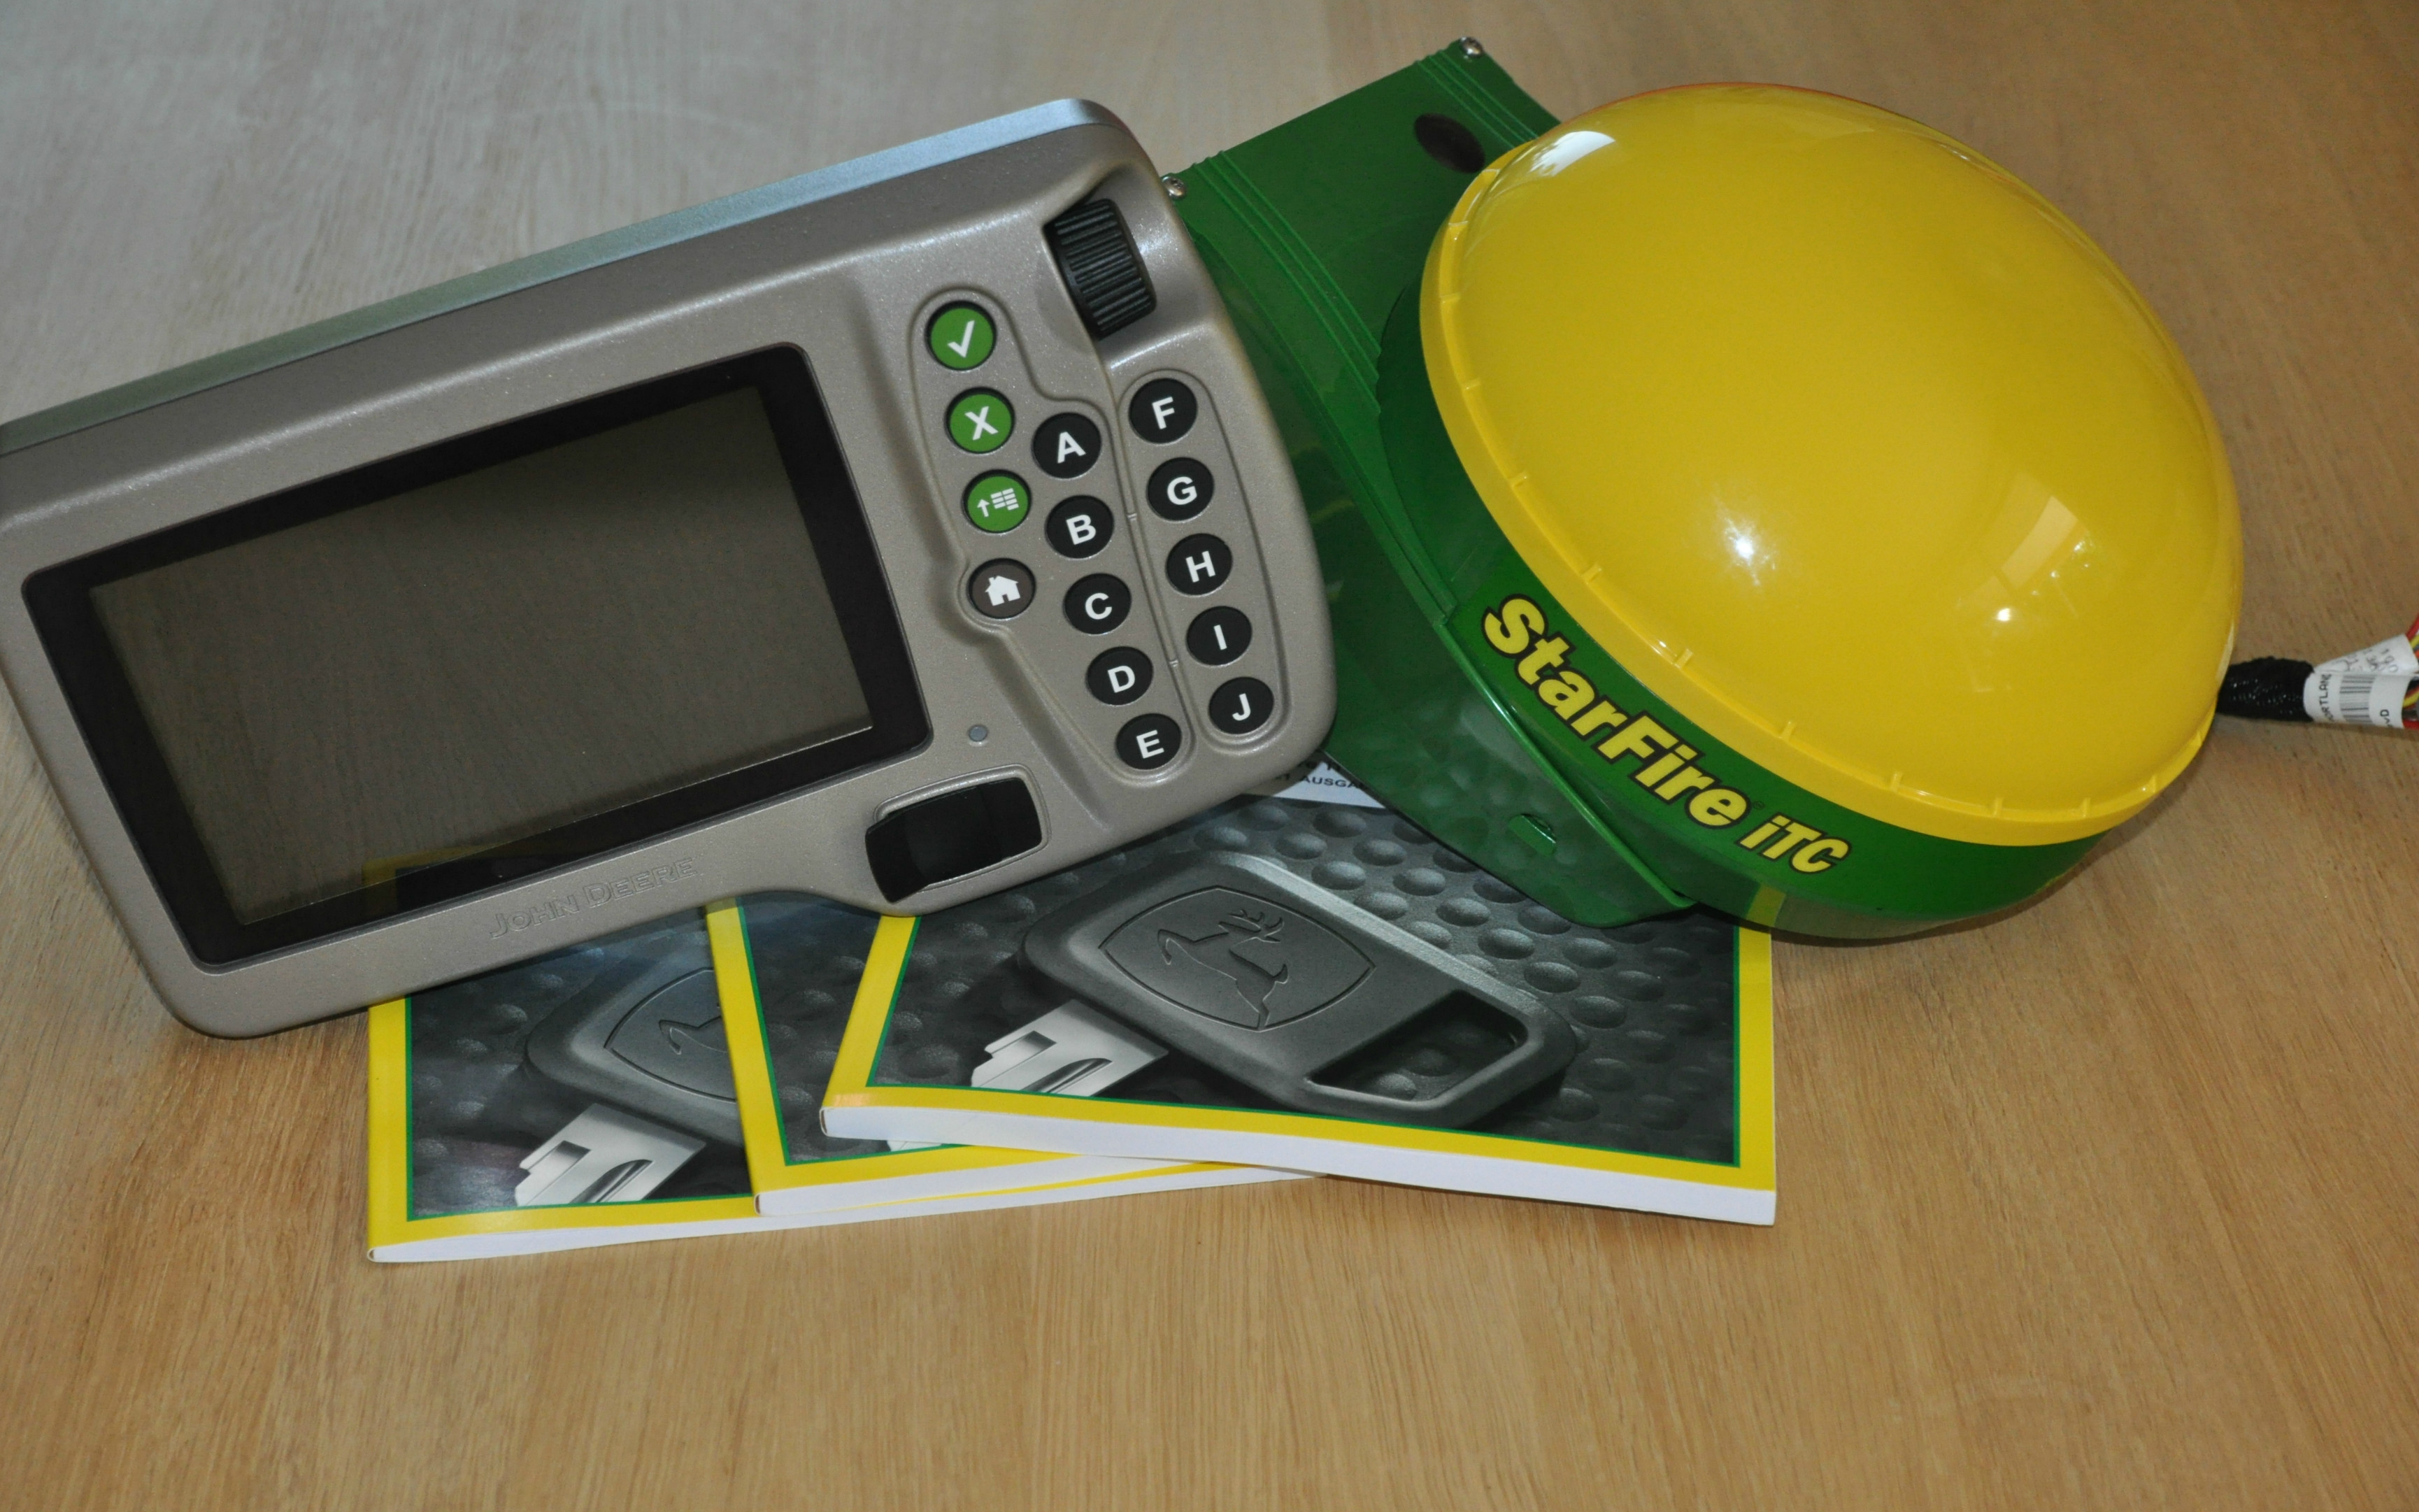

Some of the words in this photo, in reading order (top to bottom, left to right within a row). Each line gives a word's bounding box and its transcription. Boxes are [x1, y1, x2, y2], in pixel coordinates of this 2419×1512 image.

[1152, 397, 1175, 429] F
[1057, 432, 1086, 464] A
[1166, 476, 1197, 506] G
[1066, 514, 1097, 545] B
[1185, 550, 1216, 583] H
[1085, 592, 1113, 620] C
[1213, 625, 1227, 650] I
[1107, 665, 1136, 693] D
[1232, 693, 1251, 721] J
[1136, 729, 1164, 759] E
[1480, 593, 1752, 828] StarFire
[1736, 812, 1852, 874] iTC
[490, 894, 580, 939] JOHN
[583, 857, 698, 908] DEERE
